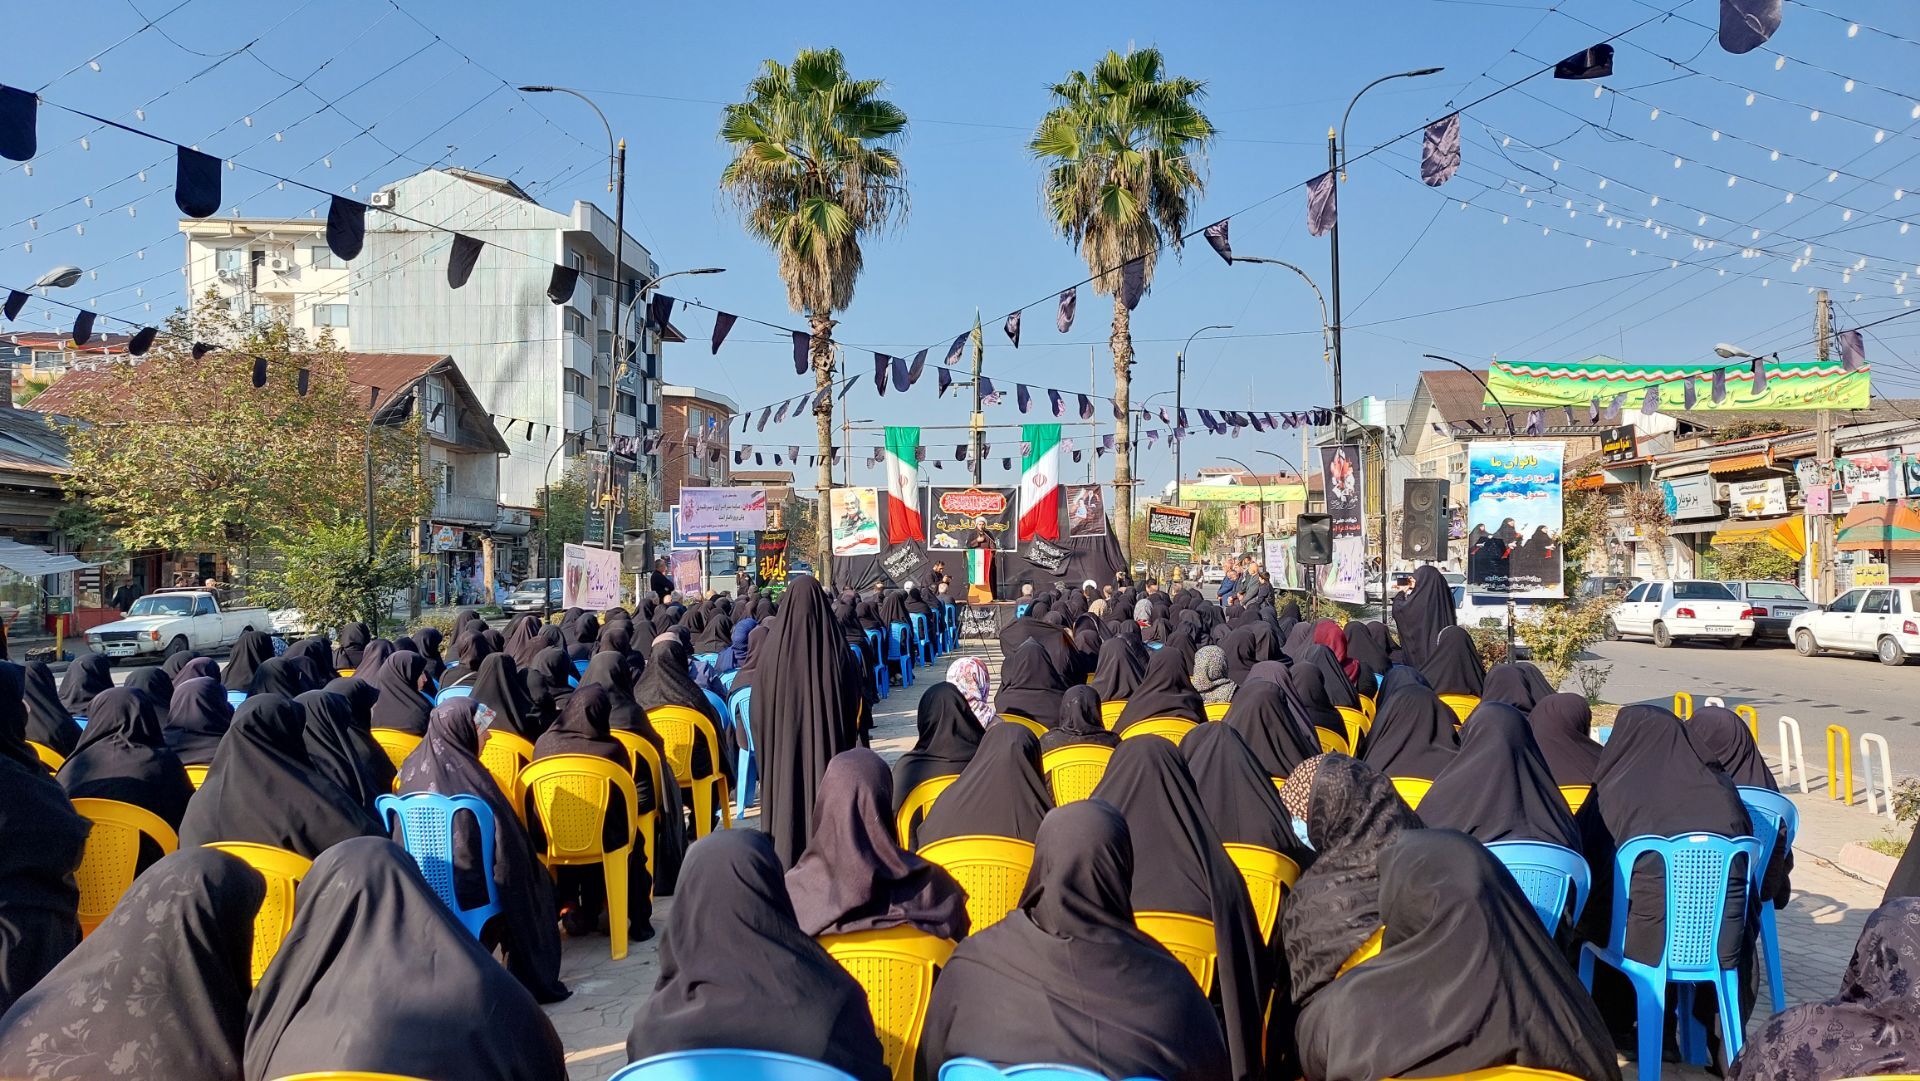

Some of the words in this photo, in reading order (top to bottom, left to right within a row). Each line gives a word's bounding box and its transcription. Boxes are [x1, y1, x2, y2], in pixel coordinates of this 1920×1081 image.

[1490, 456, 1502, 467] ما
[1504, 454, 1538, 469] بانوان
[1474, 474, 1495, 485] کشور
[1522, 474, 1533, 484] در
[1534, 473, 1555, 483] امروز
[1523, 490, 1549, 500] مشغول
